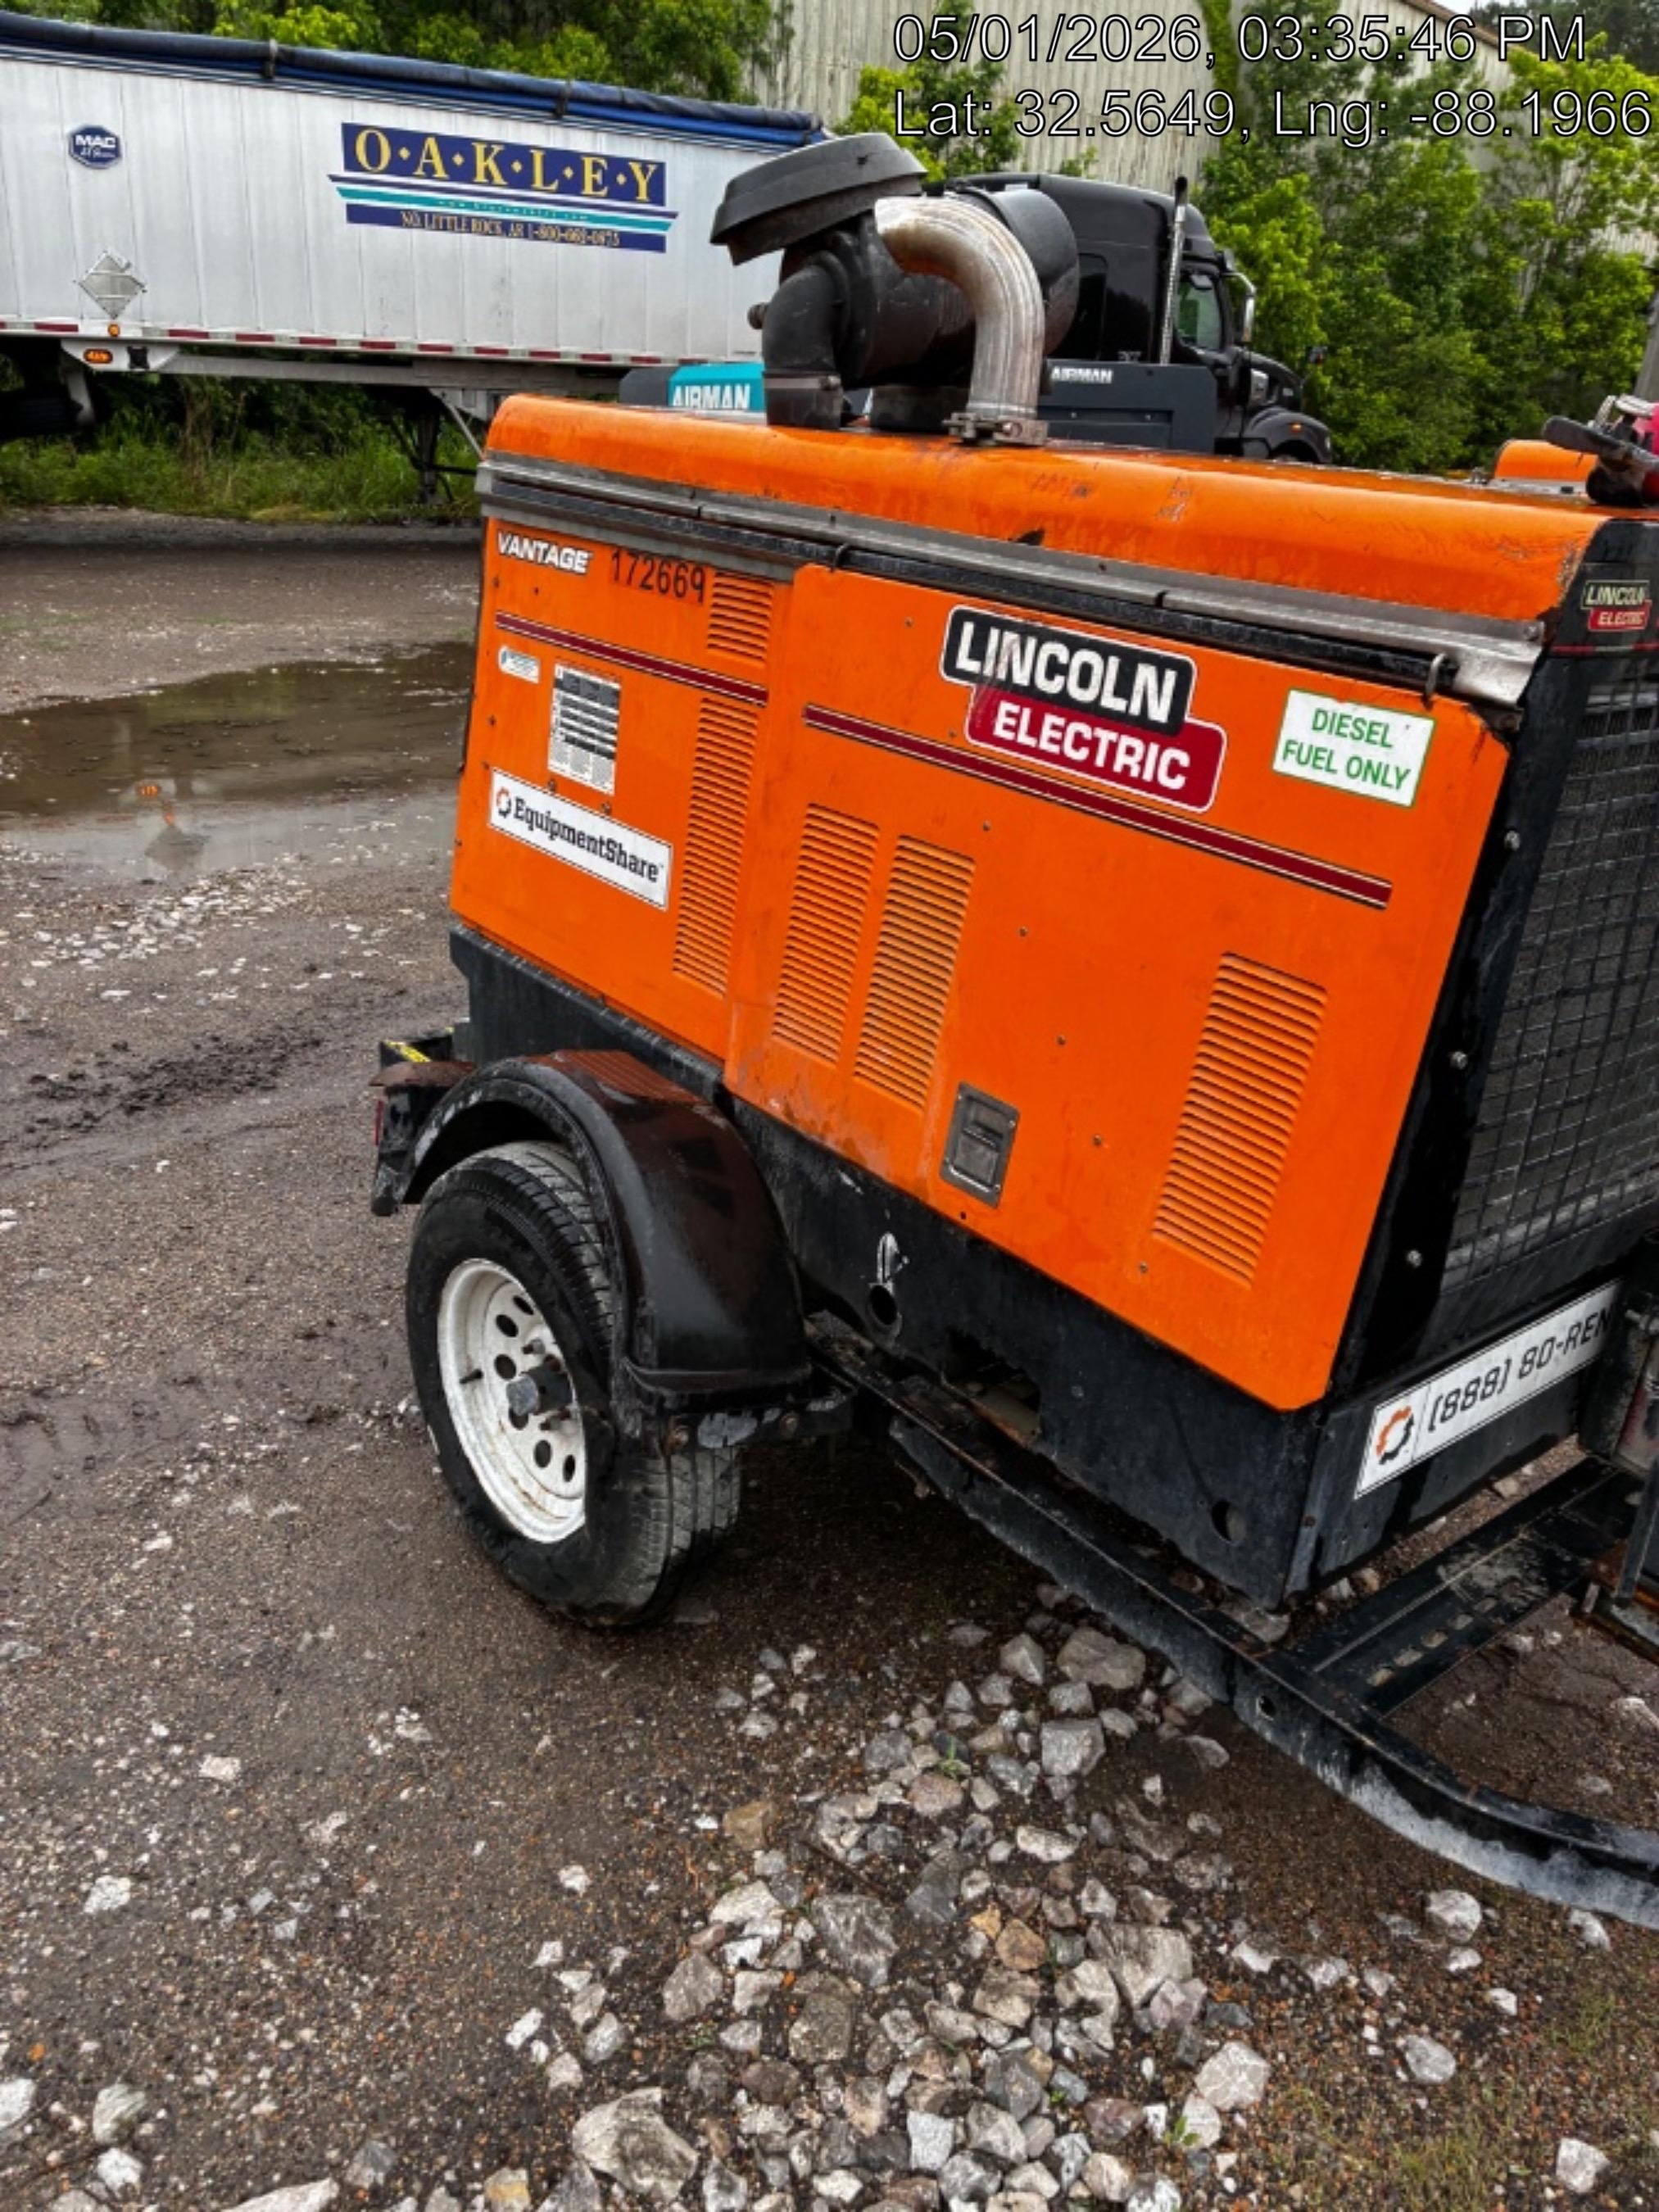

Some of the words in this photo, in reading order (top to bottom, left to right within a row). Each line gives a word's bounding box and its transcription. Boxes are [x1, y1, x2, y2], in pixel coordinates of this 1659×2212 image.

[75, 135, 116, 148] MAC
[424, 213, 466, 233] LITTLE
[673, 383, 751, 410] AIRMAN
[1051, 366, 1113, 383] AIRMAN
[496, 532, 593, 574] VANTAGE
[611, 549, 706, 604] 172669
[955, 621, 1178, 723] LINCOLN
[993, 700, 1190, 790] ELECTRIC
[1312, 708, 1393, 749] DIESEL
[1282, 739, 1338, 774] FUEL
[1346, 756, 1411, 791] ONLY
[514, 797, 660, 882] EquipmentShare
[1429, 1358, 1513, 1433] (888)
